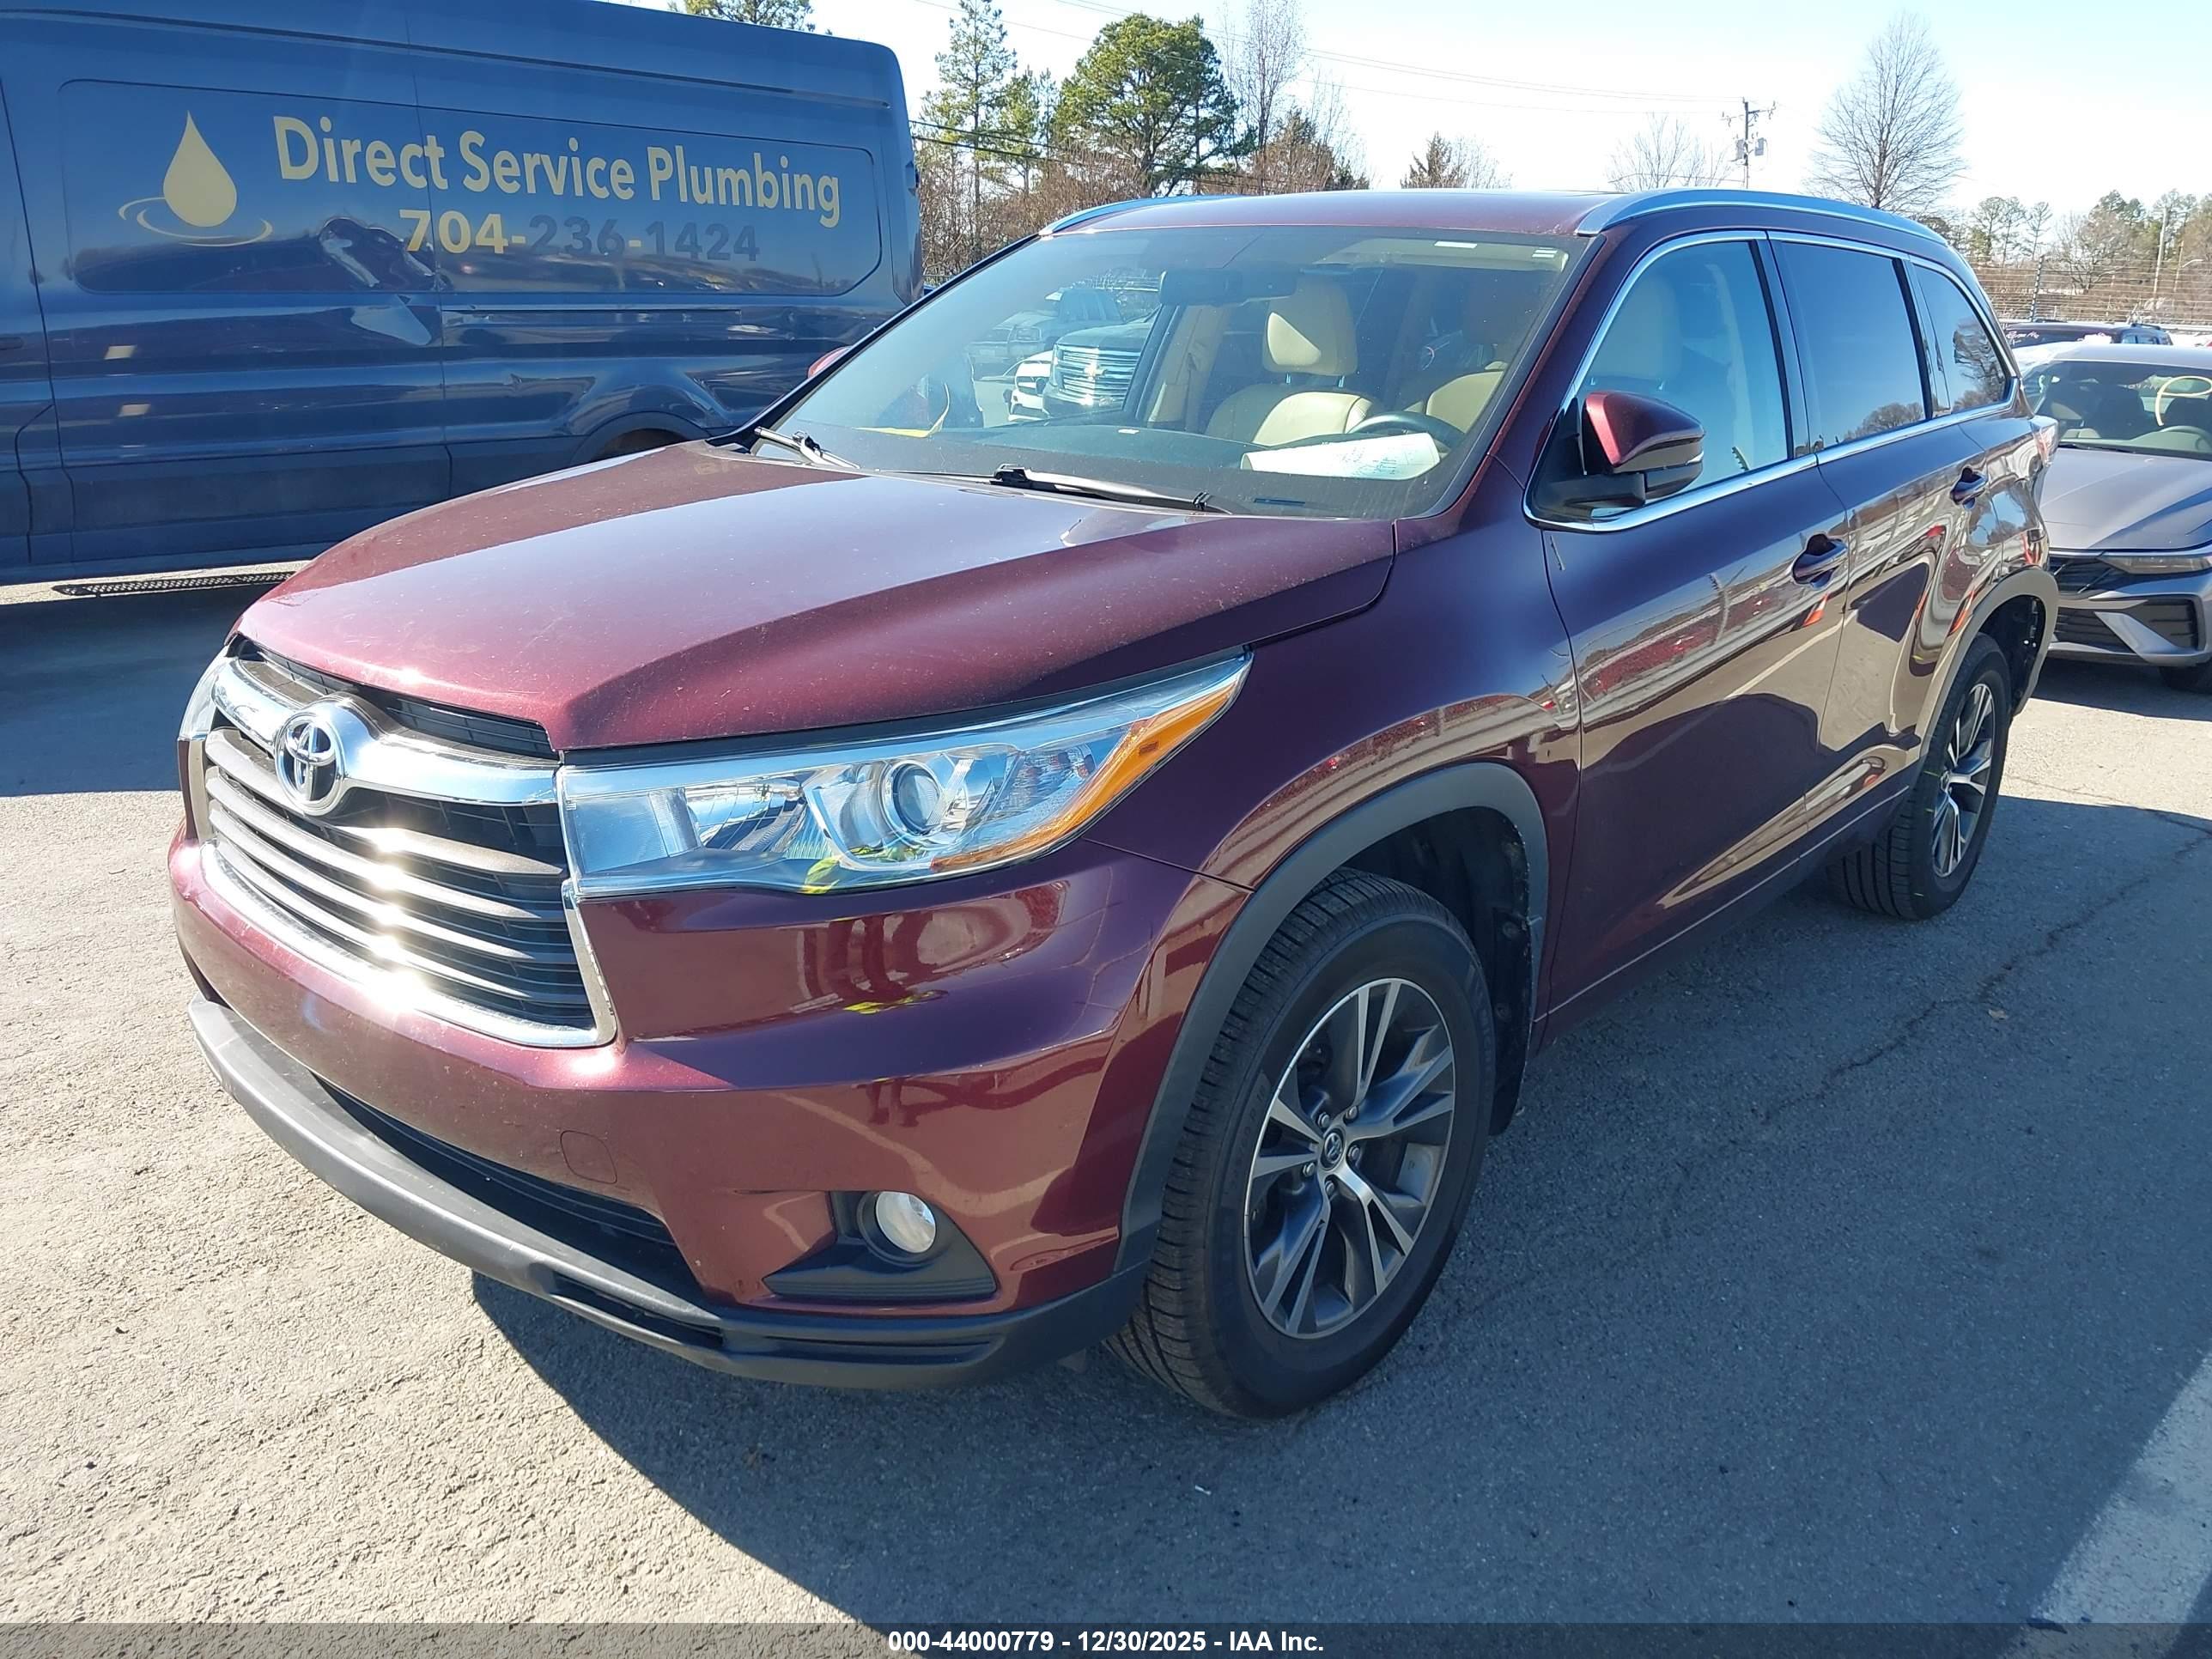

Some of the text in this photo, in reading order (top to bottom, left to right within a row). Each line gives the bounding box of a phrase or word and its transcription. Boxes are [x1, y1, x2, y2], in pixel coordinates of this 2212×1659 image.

[273, 115, 842, 230] Direct Service Plumbing
[398, 208, 761, 263] 704-236-1424
